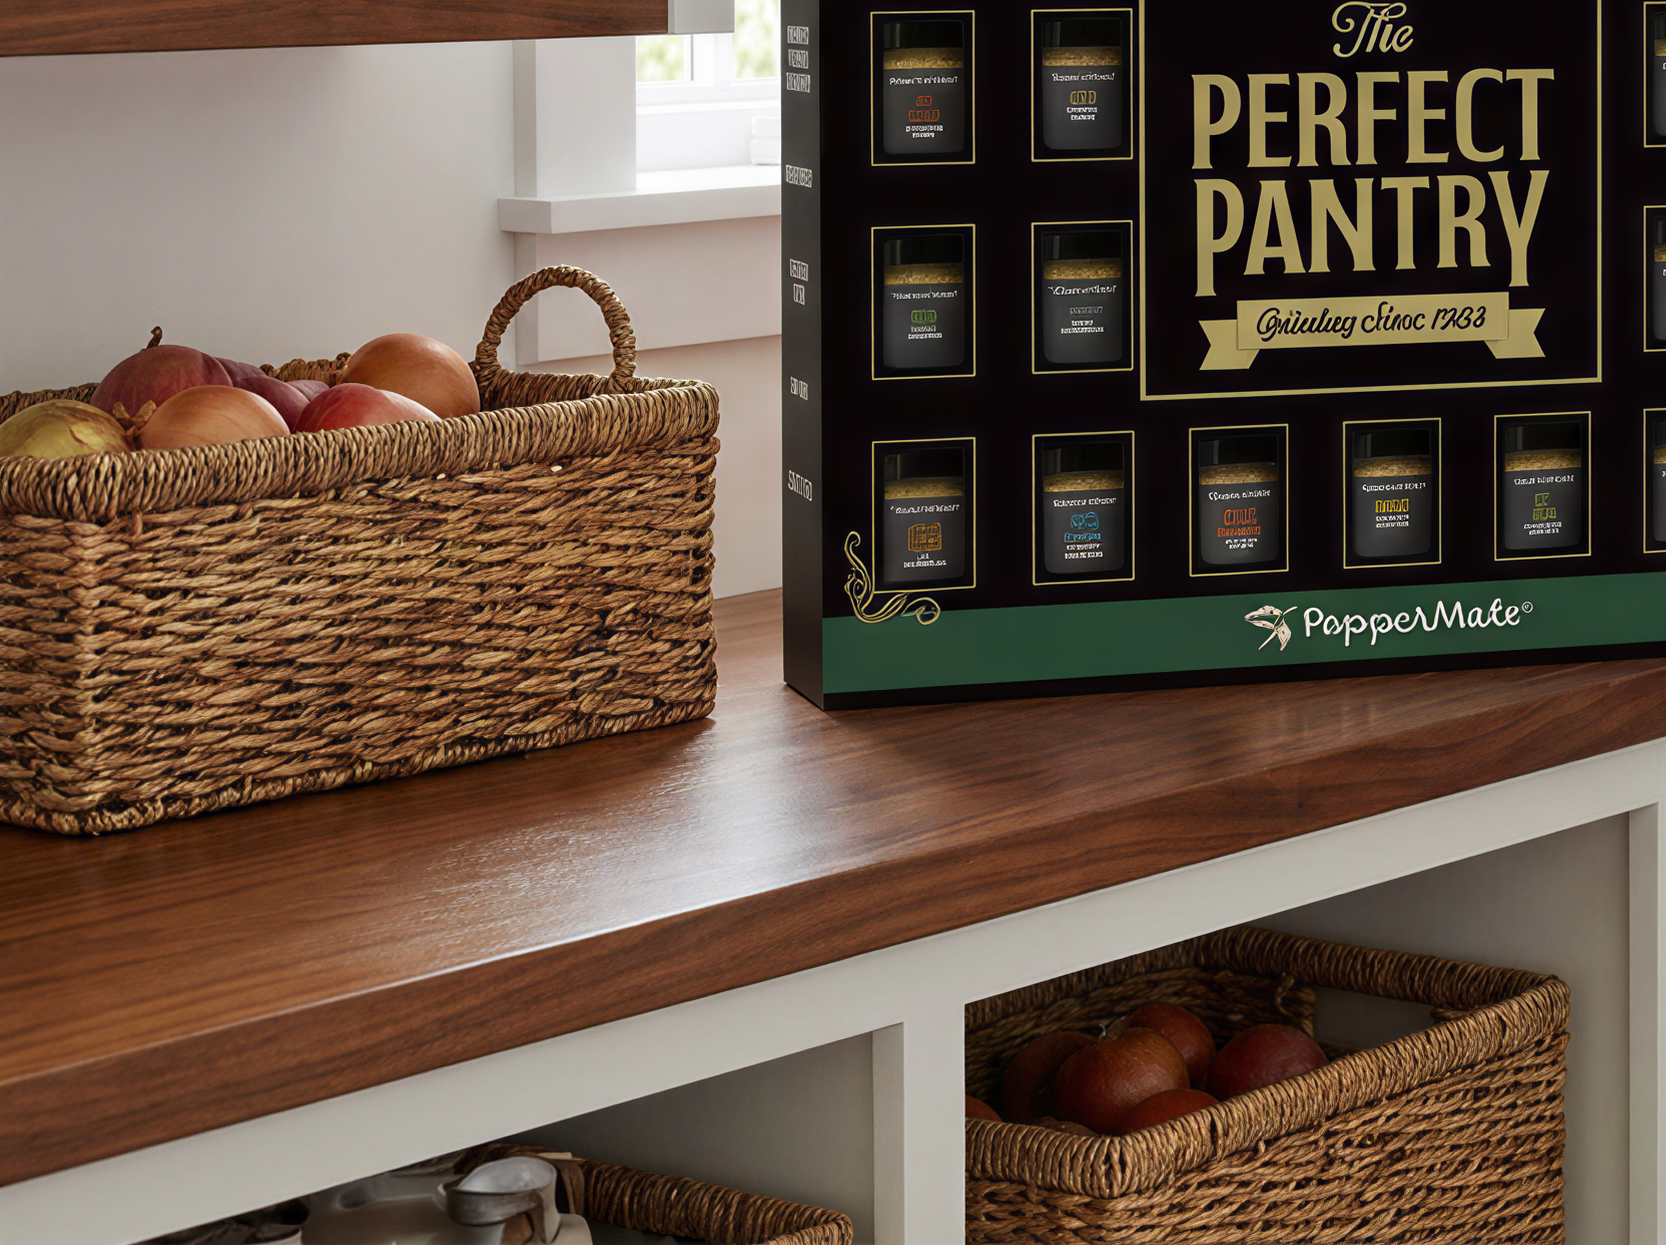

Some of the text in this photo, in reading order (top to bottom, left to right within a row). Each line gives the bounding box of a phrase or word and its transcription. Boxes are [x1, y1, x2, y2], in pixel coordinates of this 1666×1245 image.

[1331, 0, 1414, 58] The
[1191, 68, 1555, 169] PERFECT
[1193, 170, 1550, 296] PANTRY
